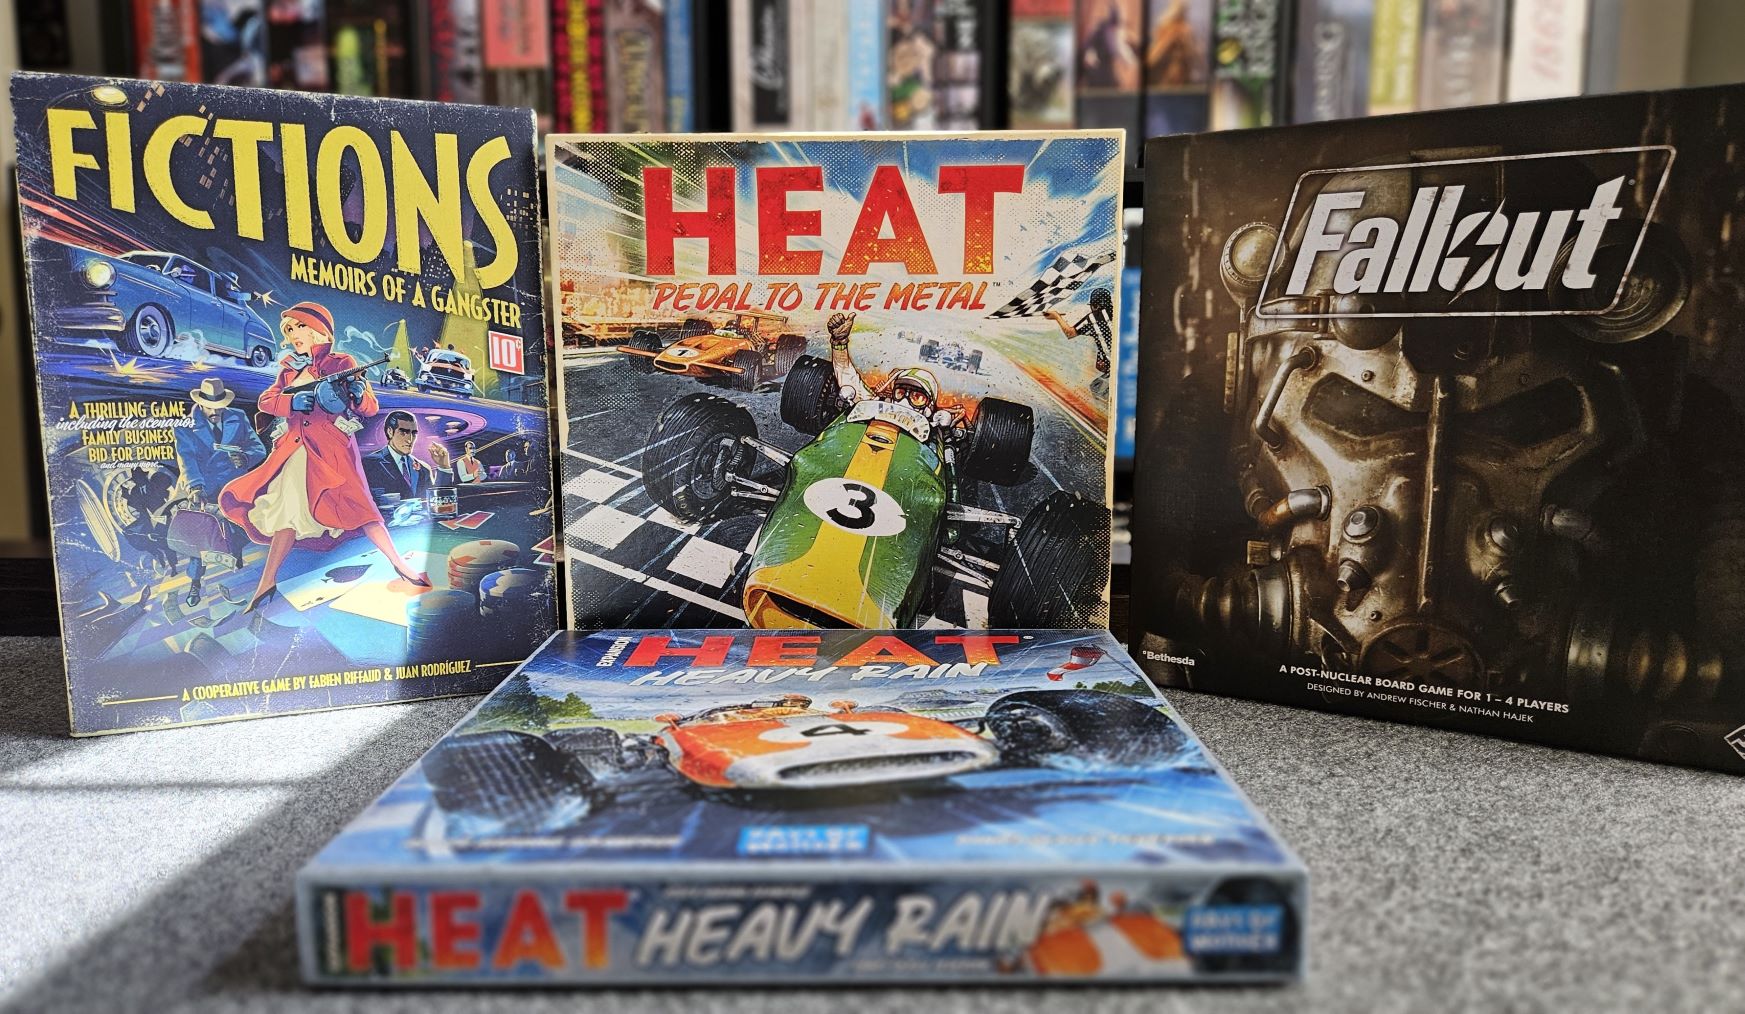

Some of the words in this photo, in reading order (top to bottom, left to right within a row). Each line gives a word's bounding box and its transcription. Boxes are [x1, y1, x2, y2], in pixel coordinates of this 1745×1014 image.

[47, 107, 519, 289] FICTIONS
[642, 164, 1025, 276] HEAT
[1285, 175, 1626, 304] Fallout
[291, 254, 377, 297] MEMOIRS
[382, 274, 406, 303] OF
[411, 281, 426, 309] A
[431, 285, 522, 329] GANGSTER
[652, 282, 752, 311] PEDAL
[763, 282, 804, 311] TO
[814, 281, 878, 311] THE
[883, 281, 988, 311] METAL
[56, 415, 117, 432] including
[118, 415, 138, 429] the
[140, 416, 196, 429] scenarios
[69, 401, 80, 420] A
[84, 402, 147, 419] THRILLING
[151, 401, 187, 418] GAME
[82, 430, 121, 446] FAMILY
[88, 448, 107, 462] BID
[111, 447, 133, 461] FOR
[137, 446, 174, 460] POWER
[100, 461, 117, 469] and
[117, 462, 139, 470] many
[825, 483, 878, 529] 3
[596, 636, 633, 667] EXPANSION
[623, 635, 1019, 667] HEAT
[1146, 651, 1195, 666] Bethesda
[182, 688, 191, 701] A
[192, 681, 260, 700] COOPERATIVE
[262, 677, 291, 693] GAME
[293, 676, 306, 690] BY
[309, 673, 341, 688] FABIEN
[344, 669, 381, 684] RIFFAUD
[384, 667, 392, 680] &
[396, 664, 419, 679] JUAN
[421, 659, 471, 677] RODRÍGUEZ
[629, 666, 838, 686] HEAVY
[850, 662, 988, 681] RAIN
[1279, 664, 1288, 674] A
[1290, 666, 1372, 685] POST-NUCLEAR
[1375, 678, 1415, 691] BOARD
[1418, 684, 1453, 697] GAME
[1457, 689, 1481, 701] FOR
[1486, 693, 1492, 702] 1
[1505, 696, 1513, 705] 4
[1517, 697, 1569, 713] PLAYERS
[1307, 682, 1352, 696] DESIGNED
[1353, 689, 1365, 698] BY
[1366, 692, 1407, 704] ANDREW
[1409, 697, 1447, 710] FISCHER
[1449, 703, 1456, 711] &
[1459, 705, 1500, 718] NATHAN
[1503, 711, 1534, 723] HAJEK
[801, 723, 871, 737] 4
[344, 888, 629, 971] HEAT
[634, 897, 874, 966] HEAVY
[885, 892, 1048, 956] RAIN
